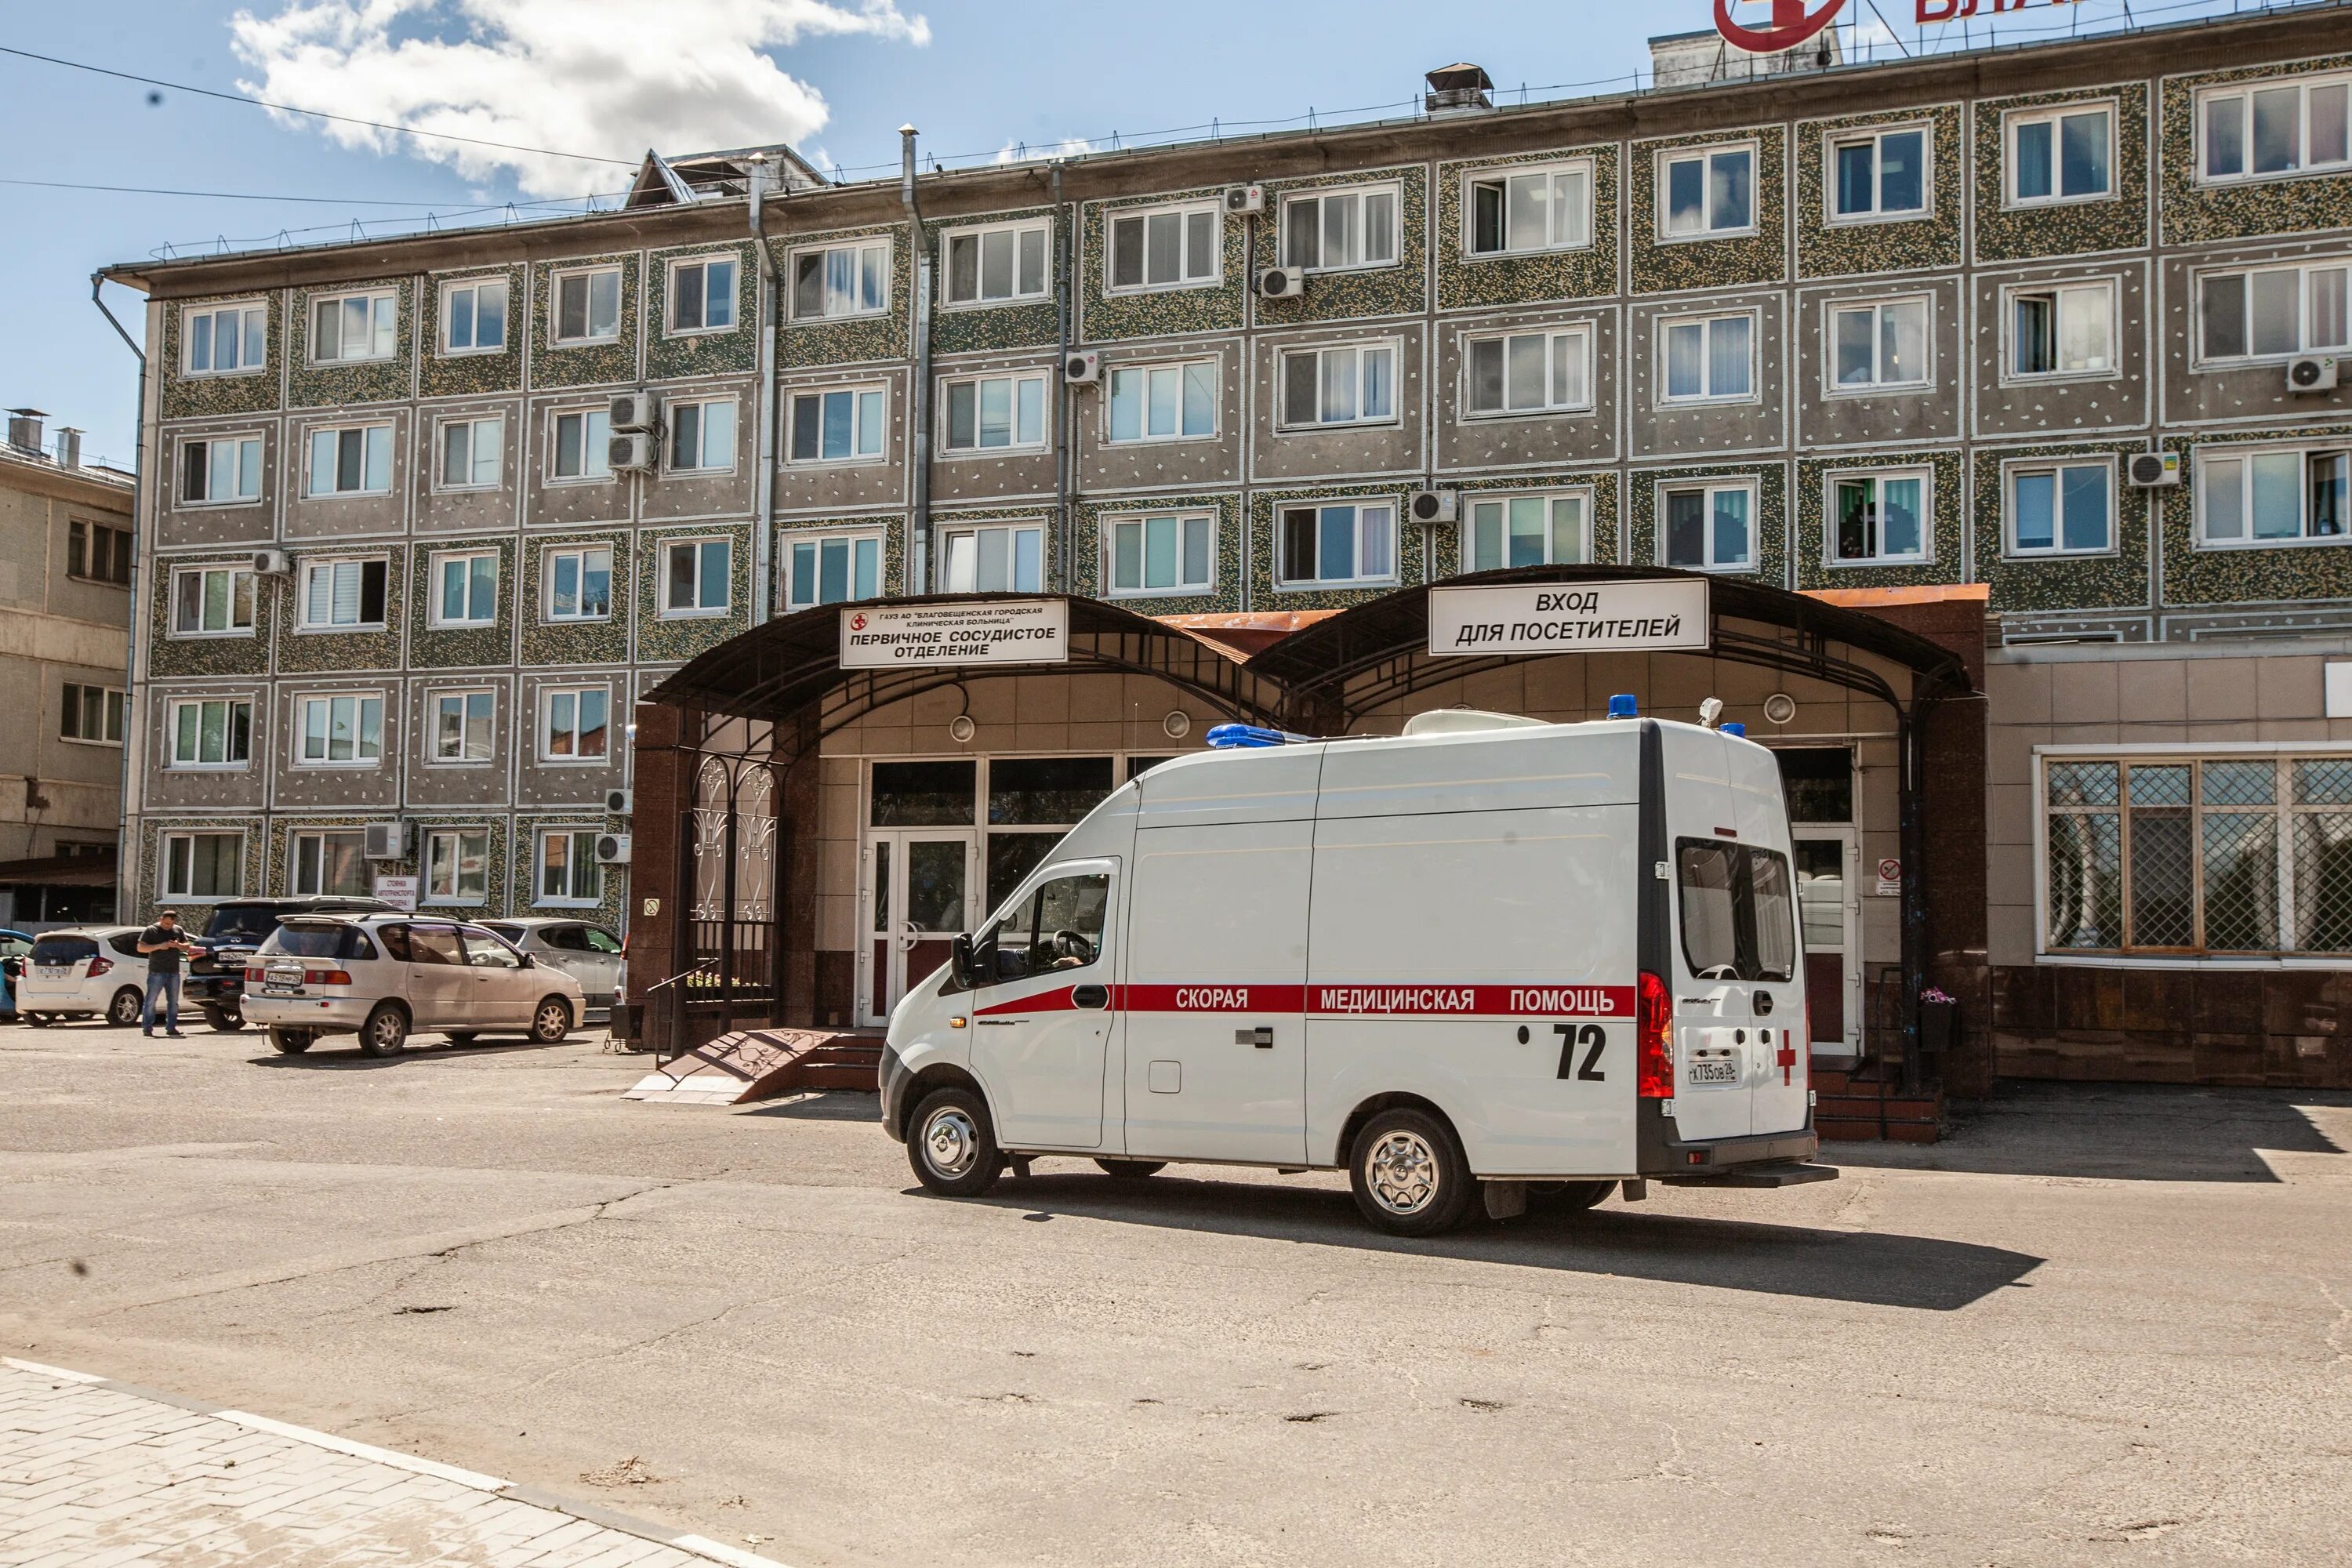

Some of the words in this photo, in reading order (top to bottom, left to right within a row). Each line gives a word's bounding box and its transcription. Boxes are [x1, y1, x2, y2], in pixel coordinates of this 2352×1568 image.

[994, 608, 1043, 616] ГОРОДСКАЯ
[1535, 592, 1599, 614] ВХОД
[906, 619, 964, 627] КЛИНИЧЕСКАЯ
[1455, 624, 1504, 646] ДЛЯ
[1510, 614, 1681, 641] ПОСЕТИТЕЛЕЙ
[850, 631, 942, 645] ПЕРВИЧНОЕ
[949, 628, 1056, 643] СОСУДИСТОЕ
[894, 644, 989, 659] ОТДЕЛЕНИЕ
[1176, 989, 1248, 1008] СКОРАЯ
[1320, 989, 1475, 1013] МЕДИЦИНСКАЯ
[1510, 989, 1614, 1015] ПОМОЩЬ
[1552, 1024, 1606, 1082] 72
